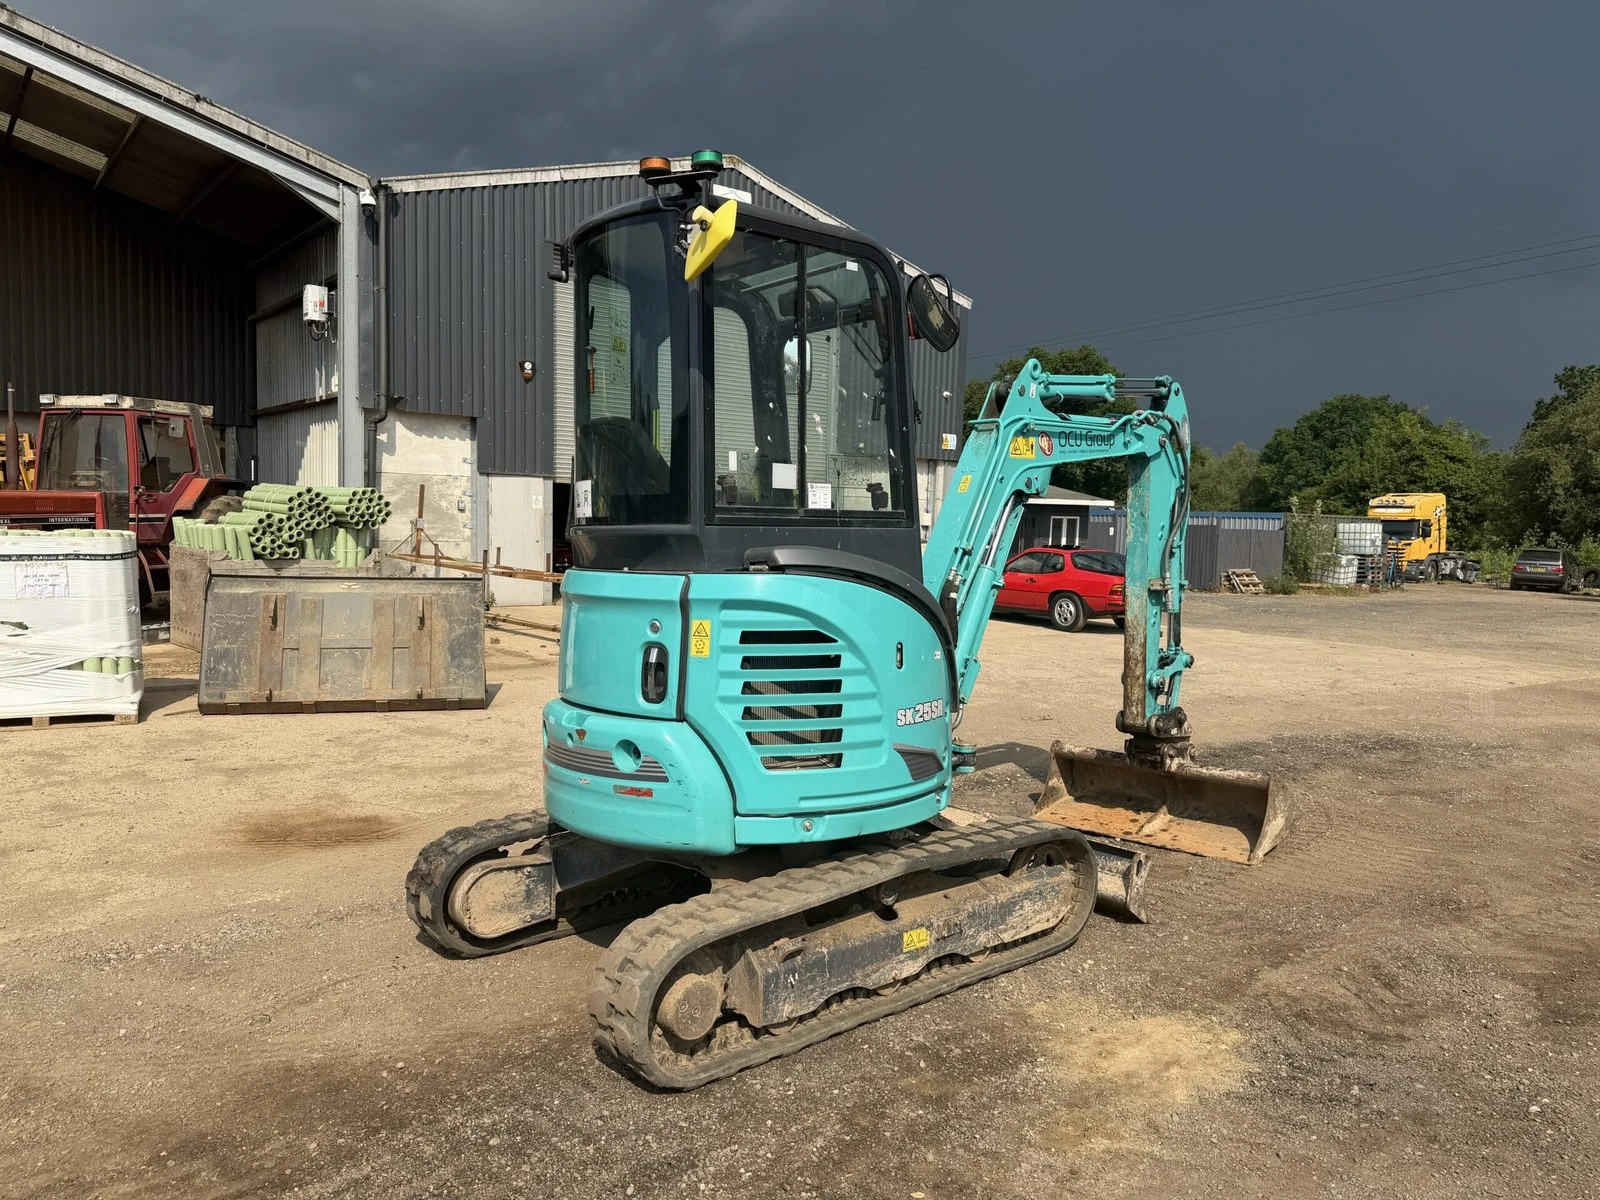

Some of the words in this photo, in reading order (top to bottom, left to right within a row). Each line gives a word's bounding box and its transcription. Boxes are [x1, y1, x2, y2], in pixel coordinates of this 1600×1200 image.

[1058, 431, 1082, 447] OCU
[1085, 431, 1115, 449] Group
[896, 698, 944, 728] SK25SR
